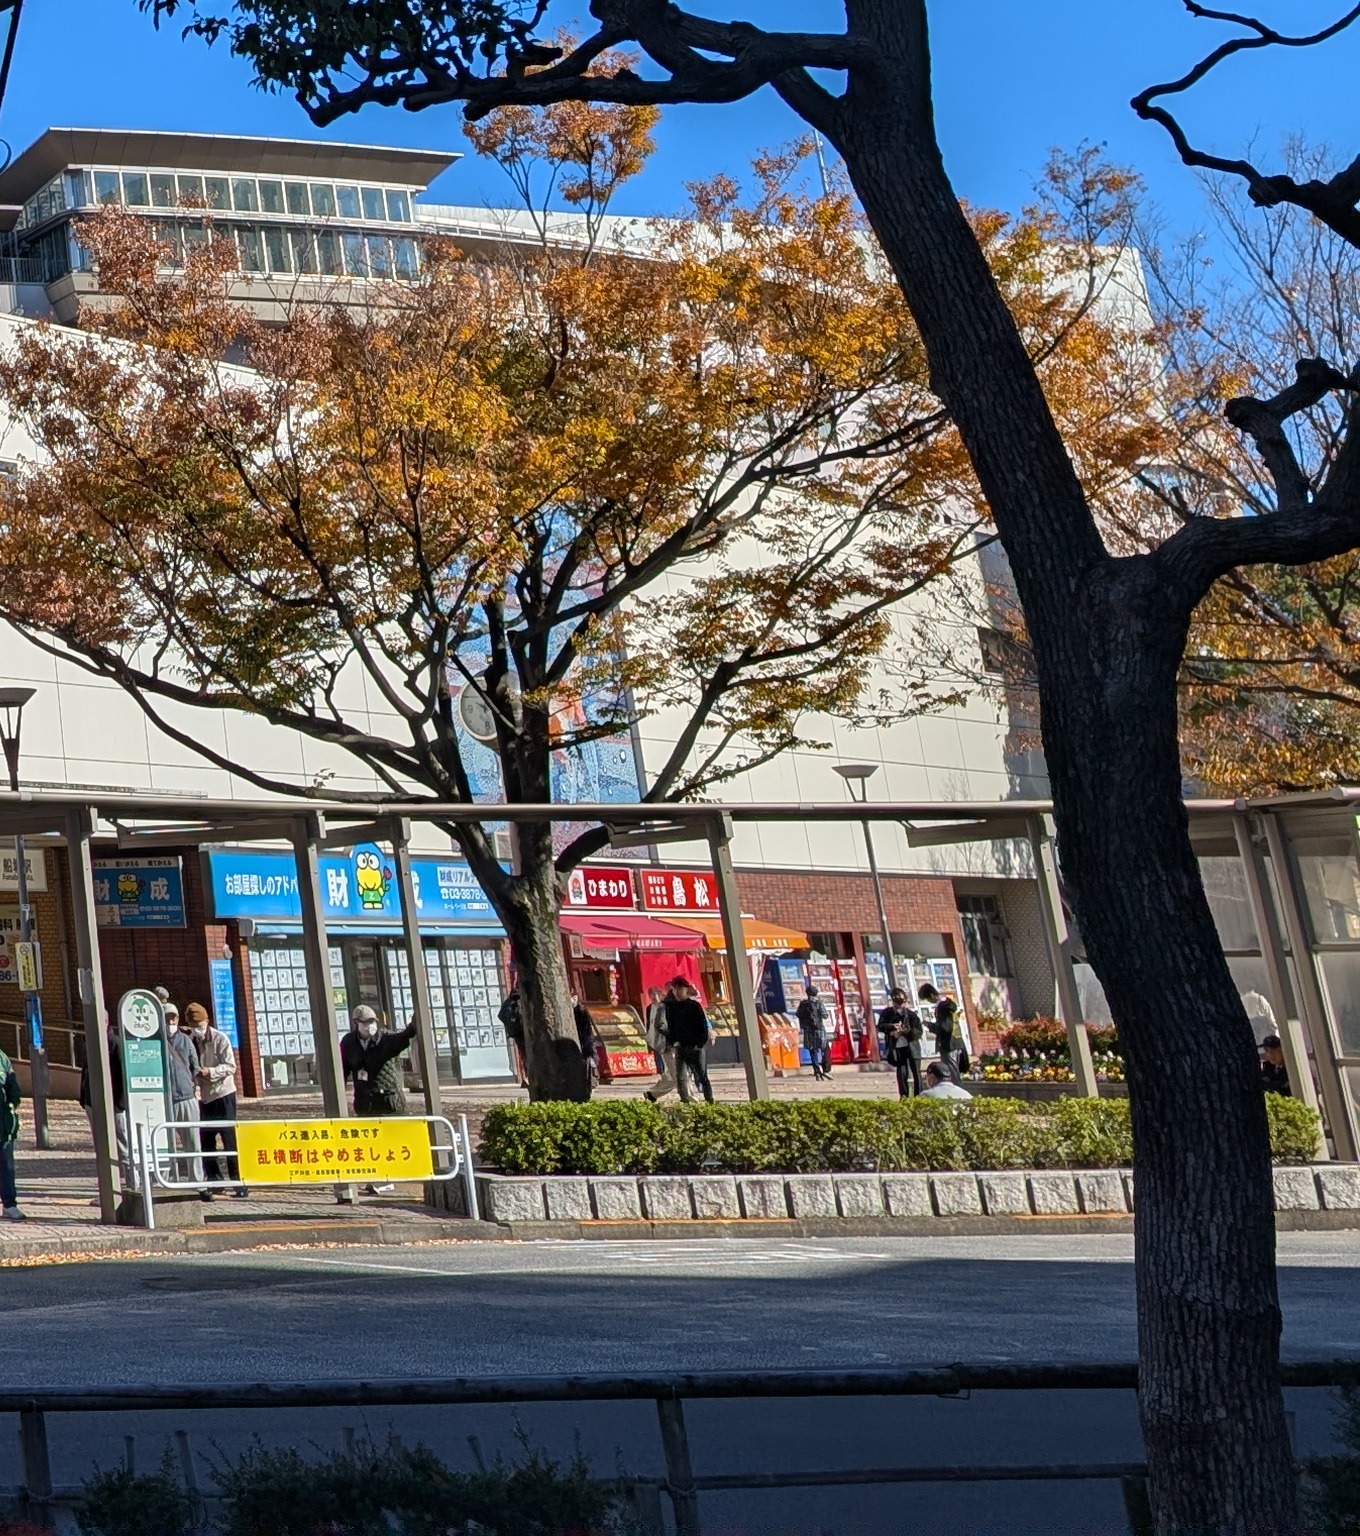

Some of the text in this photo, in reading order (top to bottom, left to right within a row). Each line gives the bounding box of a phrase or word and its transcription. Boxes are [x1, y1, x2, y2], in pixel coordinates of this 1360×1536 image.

[326, 868, 349, 908] 財
[587, 879, 627, 898] ひまわり
[257, 1145, 411, 1165] 乱横断はやめましょう
